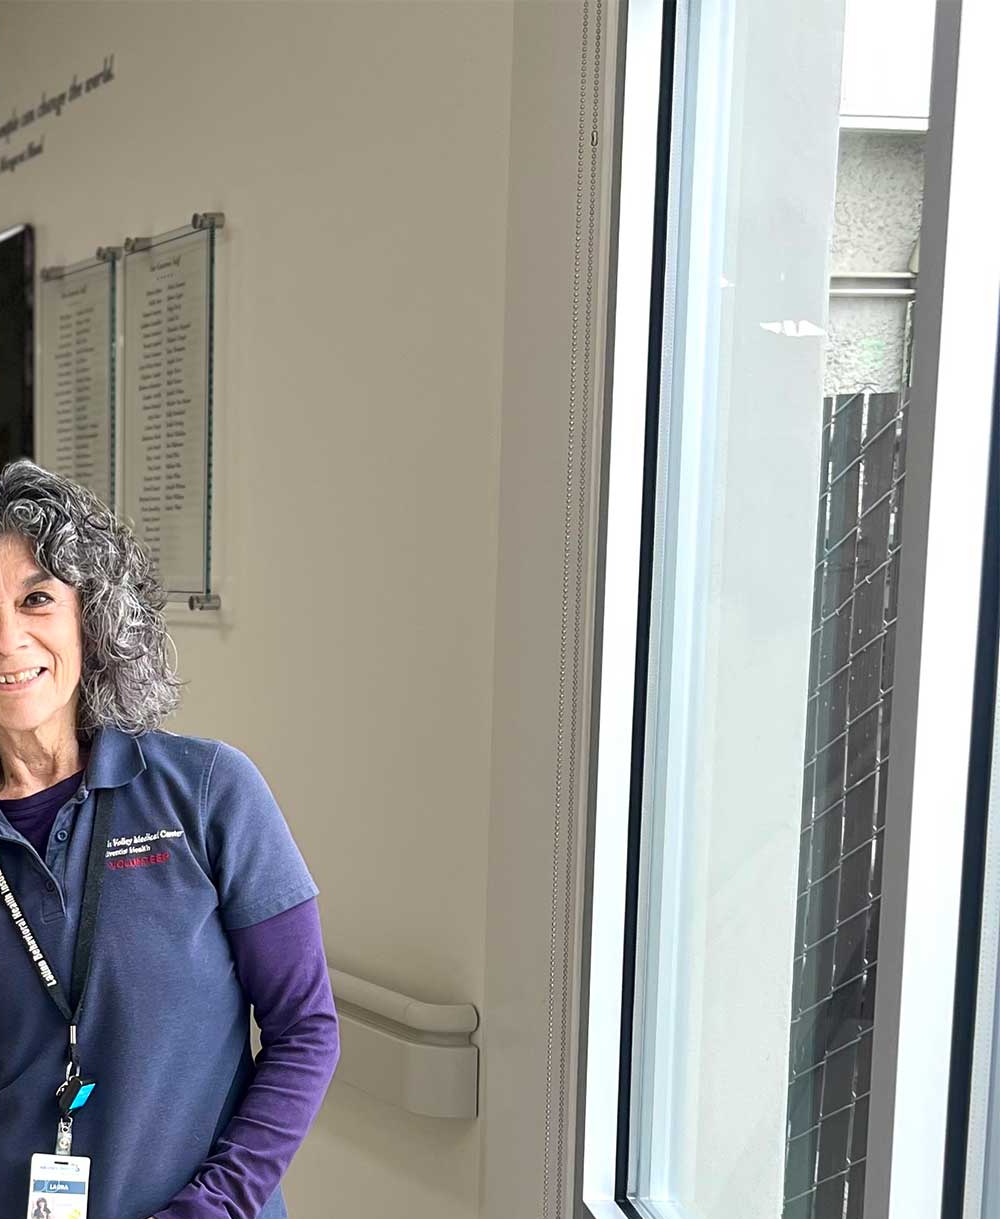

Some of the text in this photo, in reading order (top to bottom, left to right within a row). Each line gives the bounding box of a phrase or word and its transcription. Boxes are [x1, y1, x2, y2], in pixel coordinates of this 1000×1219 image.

[133, 831, 159, 843] Medical
[160, 830, 184, 838] Center
[4, 892, 22, 920] Health
[15, 917, 44, 962] Behavioral
[37, 959, 58, 987] Latino
